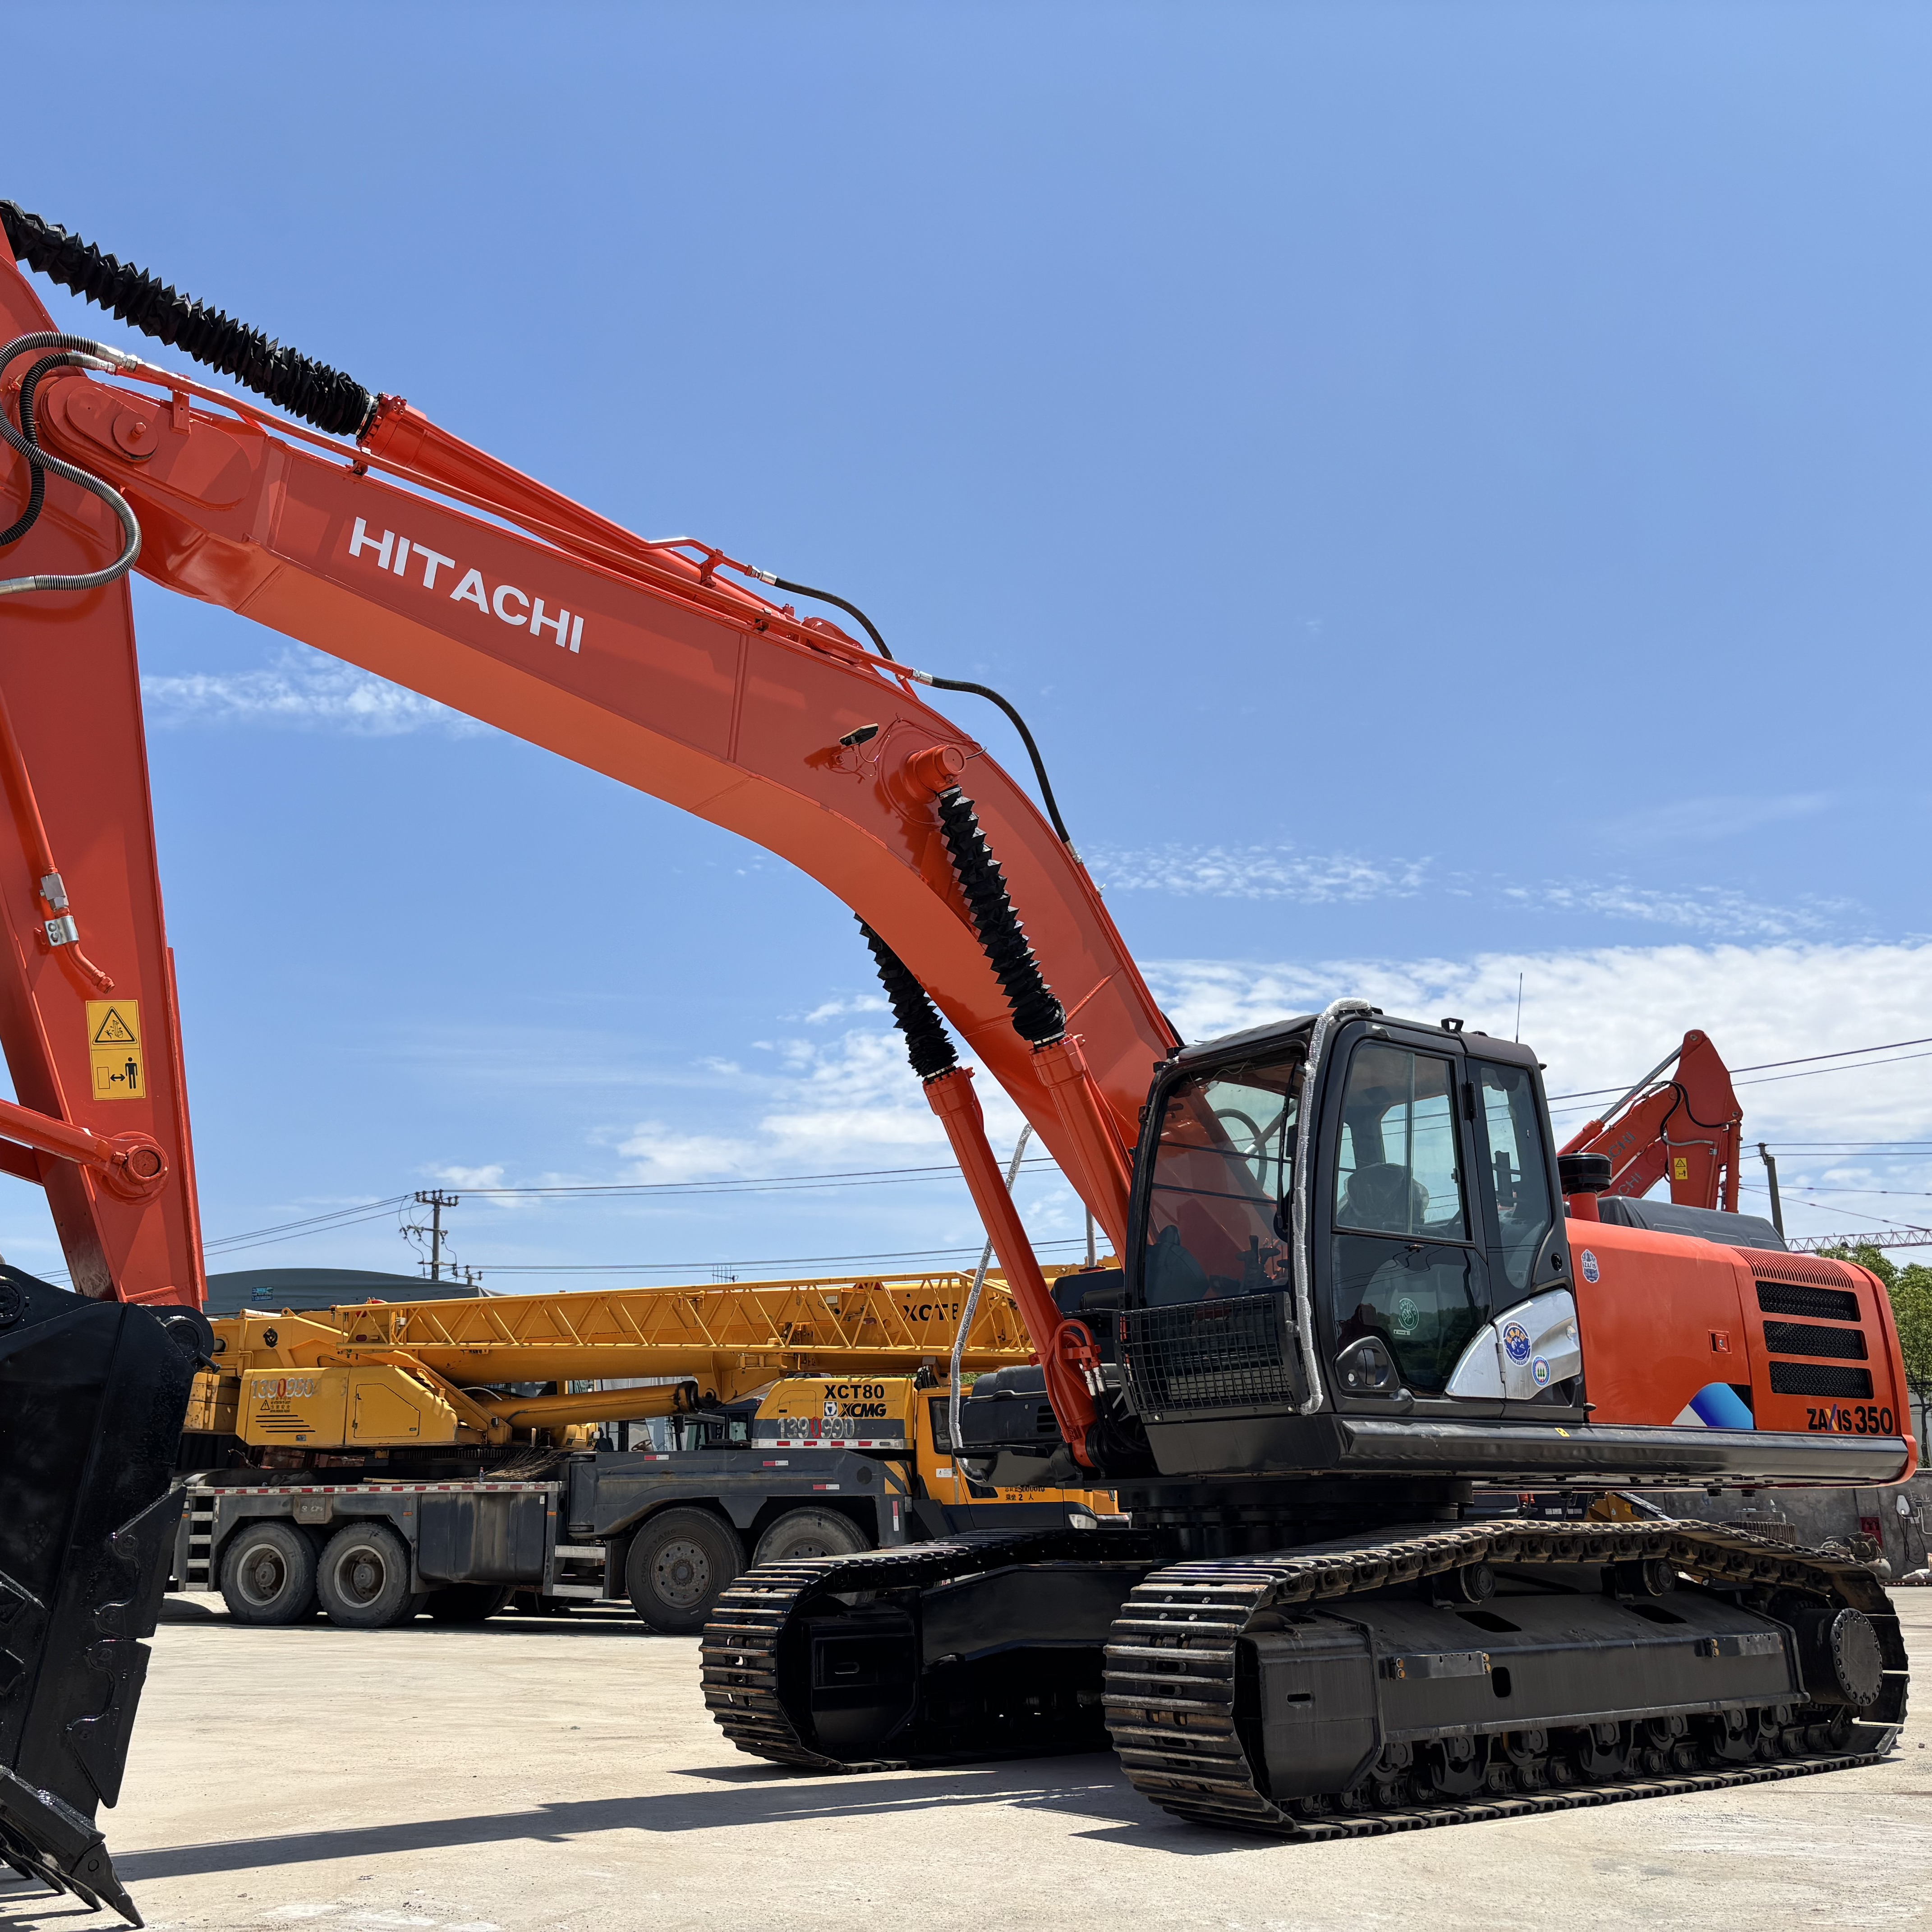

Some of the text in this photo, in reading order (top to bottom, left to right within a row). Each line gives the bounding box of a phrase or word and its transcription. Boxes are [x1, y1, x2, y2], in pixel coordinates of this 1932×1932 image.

[349, 516, 584, 653] HITACHI
[1608, 1131, 1636, 1162] CHI
[1612, 1173, 1642, 1196] CHI
[902, 1303, 975, 1321] XCT8
[824, 1384, 885, 1399] XCT80
[838, 1403, 887, 1417] XCMG
[1806, 1403, 1893, 1435] ZAXIS 350
